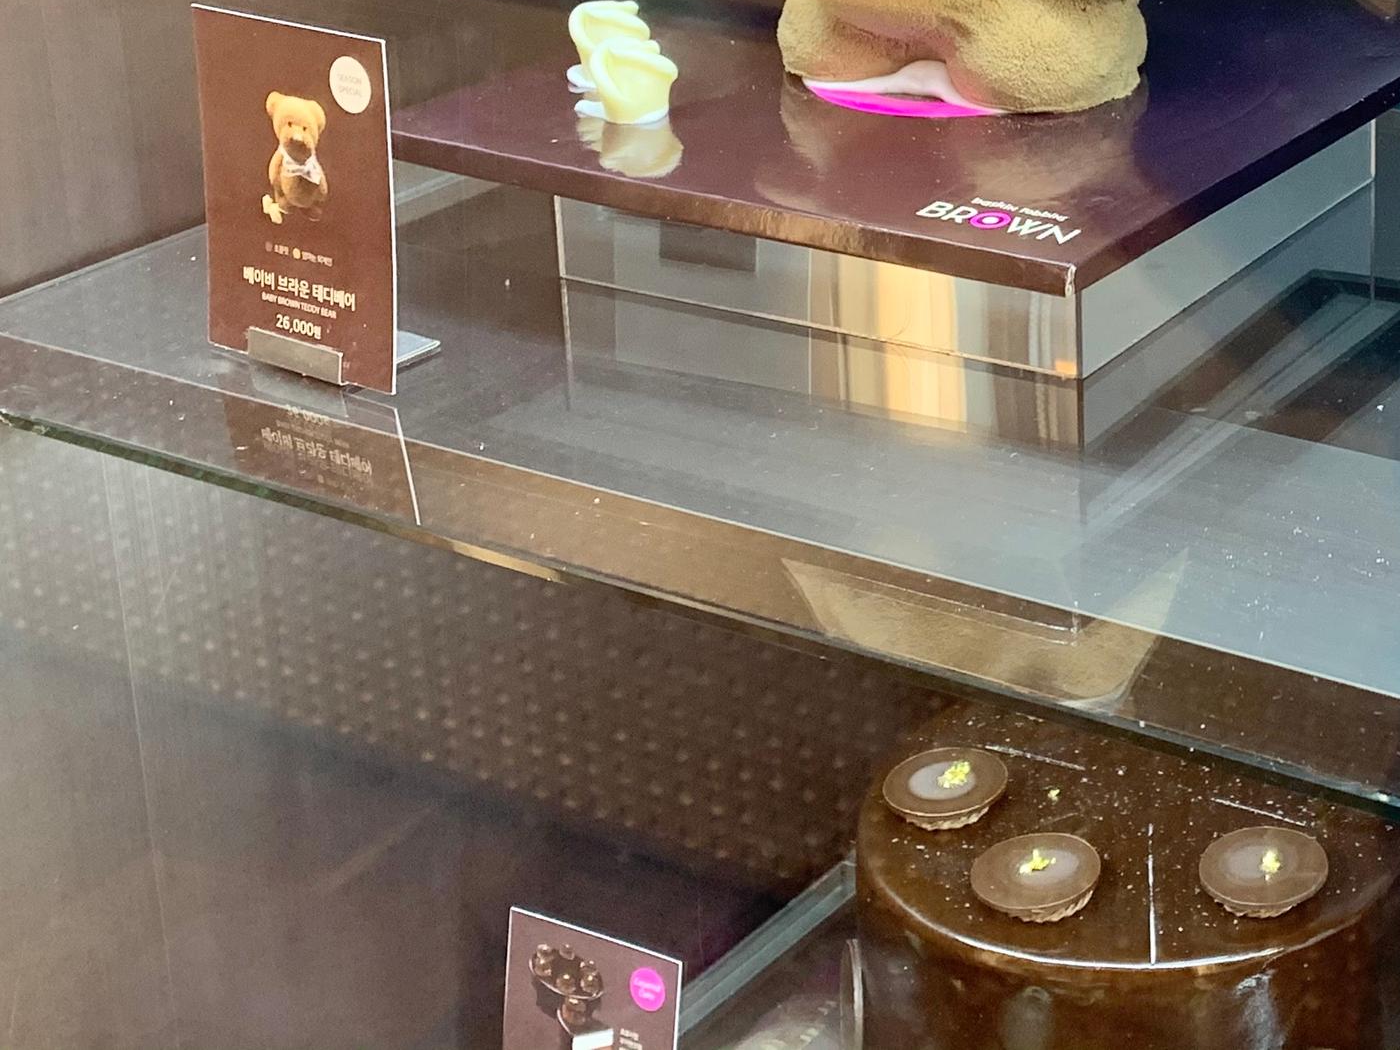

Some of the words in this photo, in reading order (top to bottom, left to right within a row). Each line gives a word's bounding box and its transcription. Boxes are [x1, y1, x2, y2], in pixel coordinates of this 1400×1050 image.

[916, 201, 1081, 245] BROWN
[243, 266, 275, 290] 베이비
[277, 275, 310, 299] 브라운
[312, 284, 356, 311] 테디베어
[276, 314, 322, 339] 26,000원
[320, 308, 337, 319] BEAR
